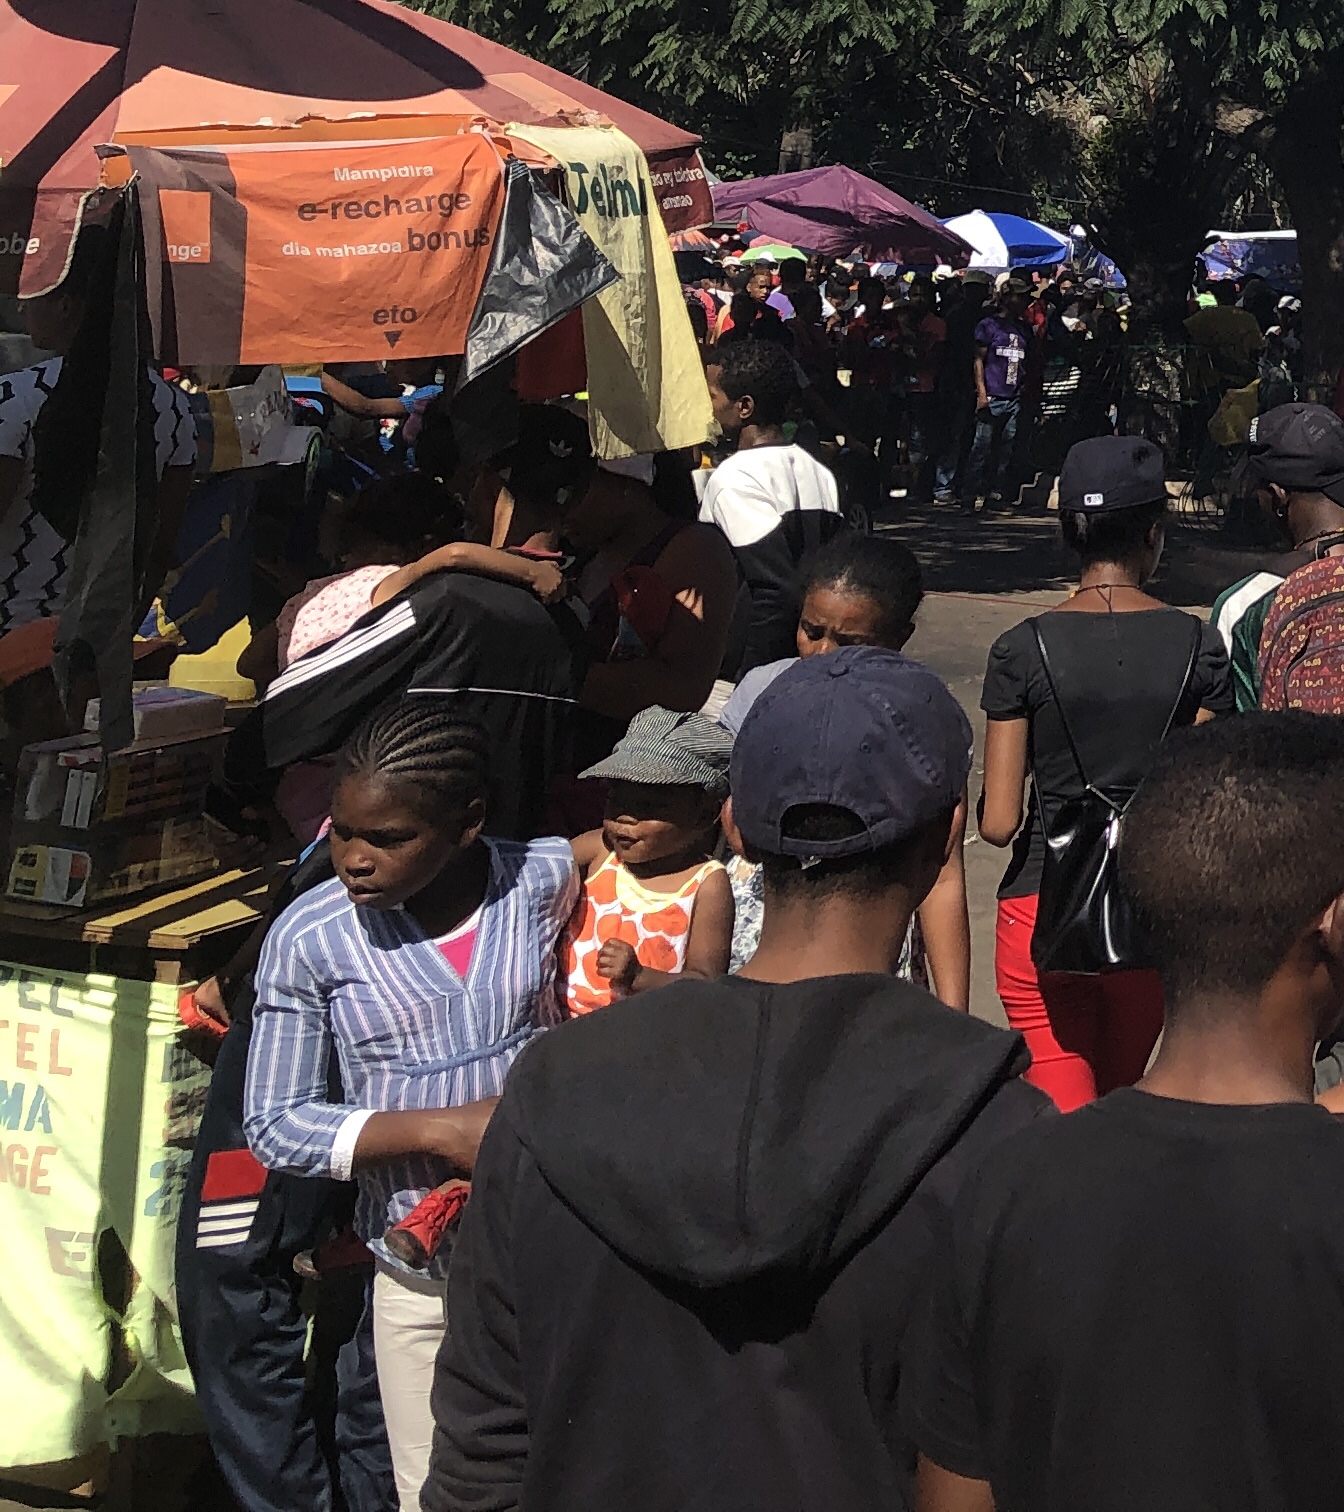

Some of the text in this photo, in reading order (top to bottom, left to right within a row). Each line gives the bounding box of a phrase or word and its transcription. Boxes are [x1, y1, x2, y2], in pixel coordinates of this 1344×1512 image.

[333, 164, 434, 183] Mampidira
[297, 189, 472, 222] e-recharge
[281, 226, 490, 258] dia mahazoa bonus
[372, 304, 419, 326] eto
